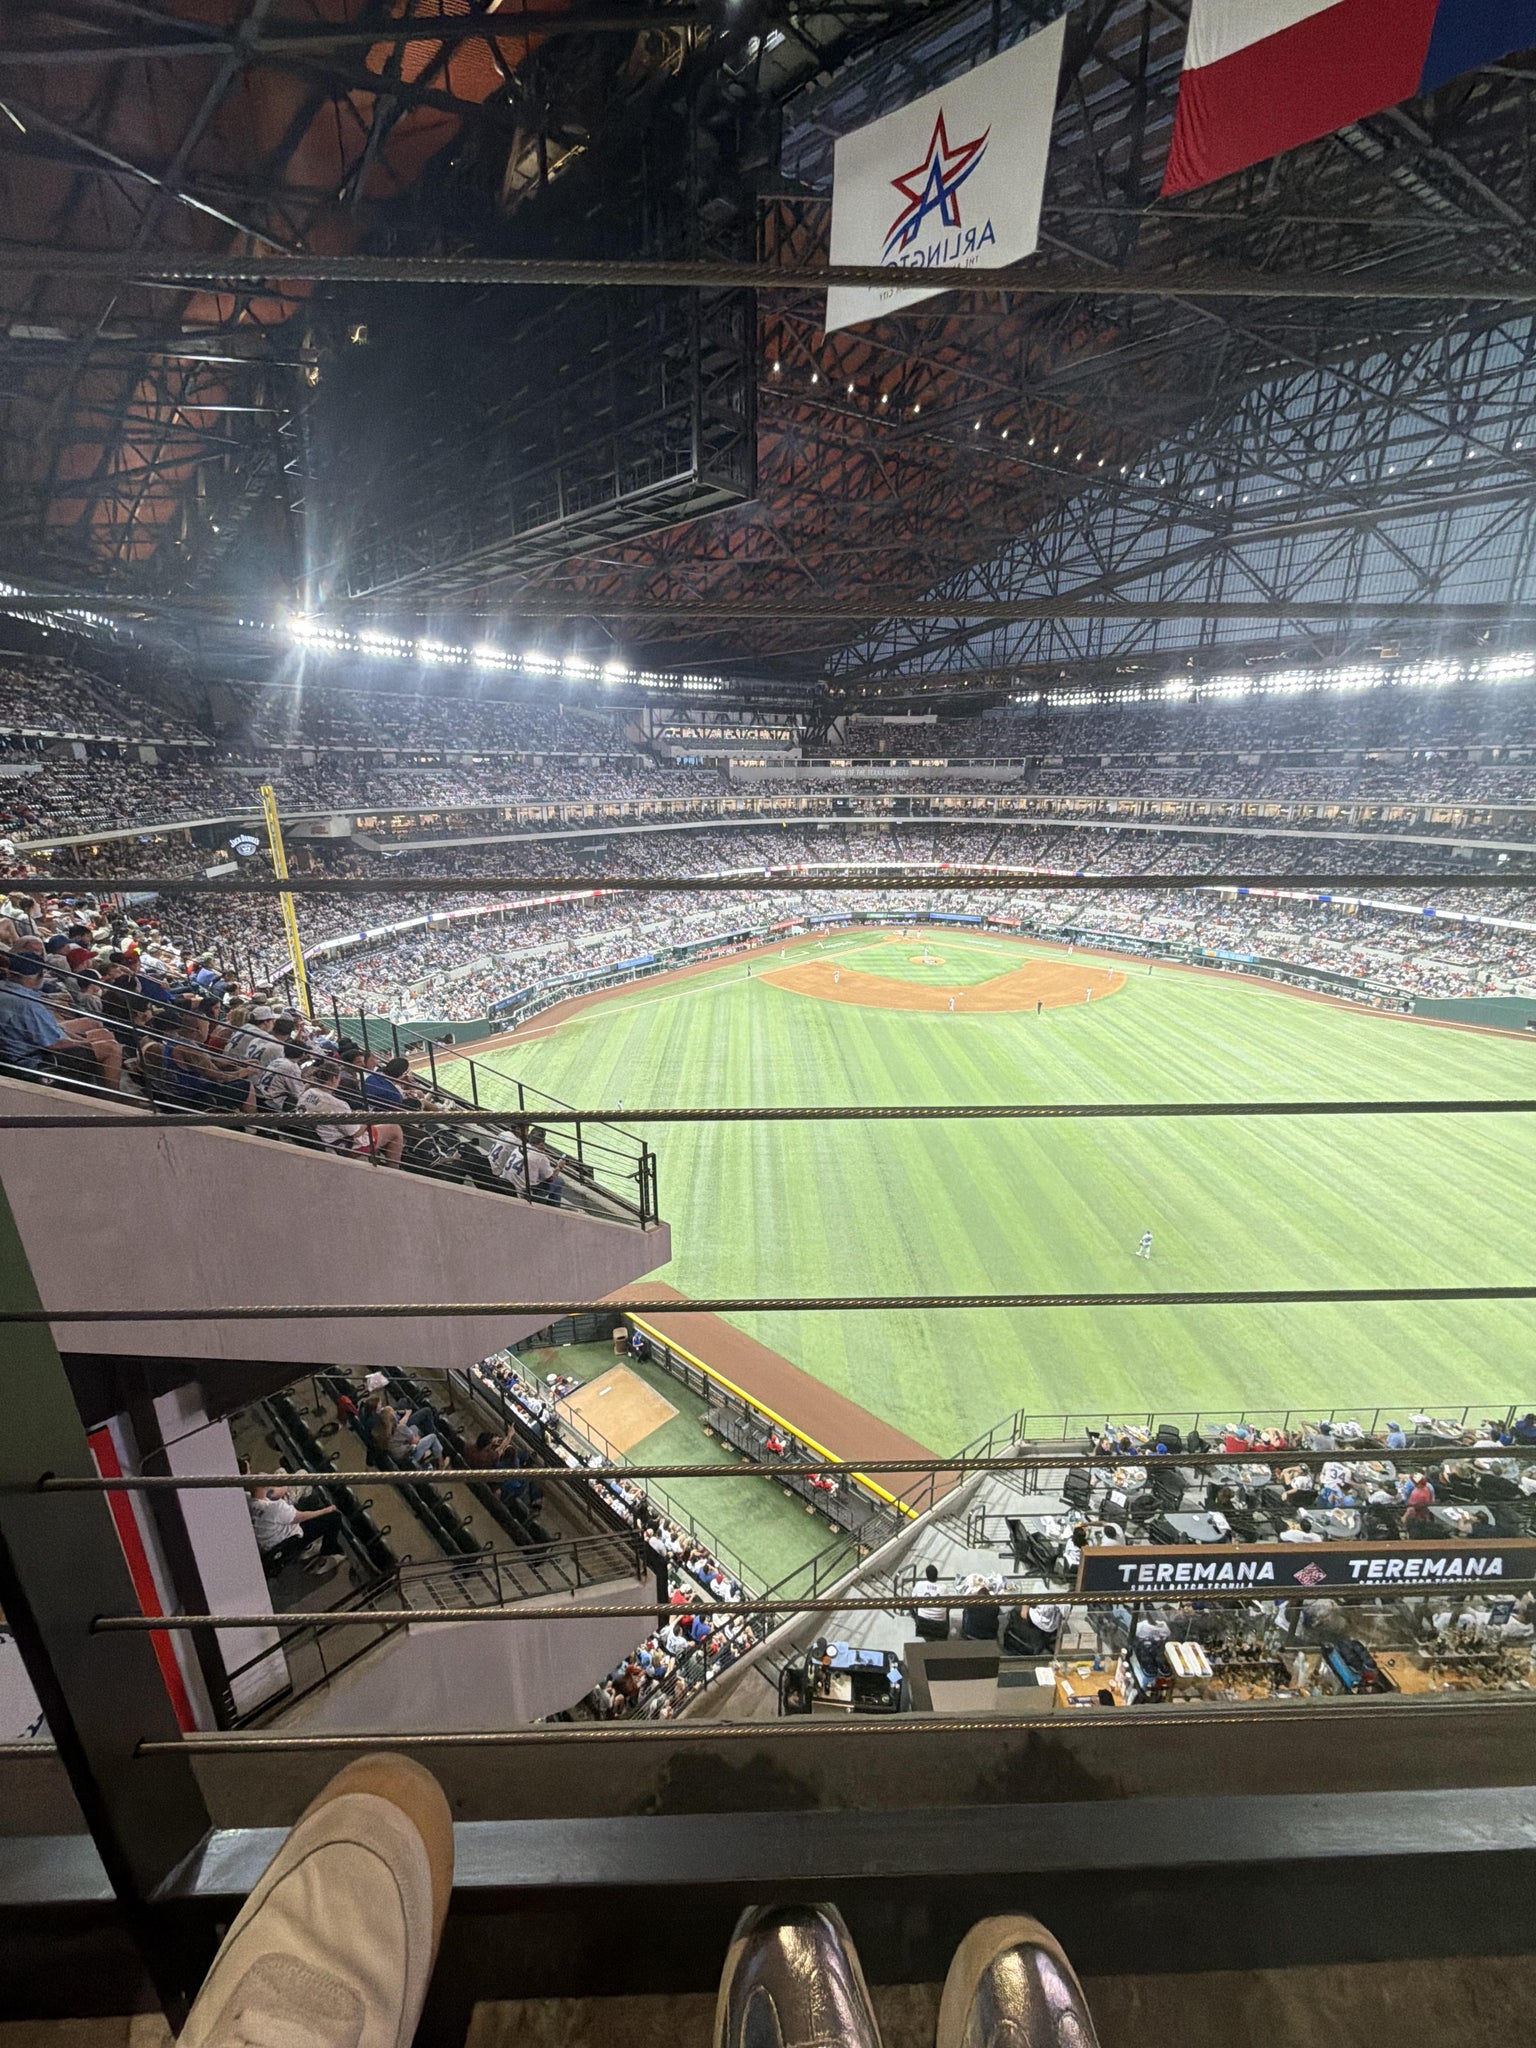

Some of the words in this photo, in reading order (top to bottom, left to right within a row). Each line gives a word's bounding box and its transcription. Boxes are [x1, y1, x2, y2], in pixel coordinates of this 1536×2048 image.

[1330, 1468, 1346, 1483] 34
[1118, 1561, 1275, 1583] TEREMANA
[1348, 1557, 1503, 1578] TEREMANA
